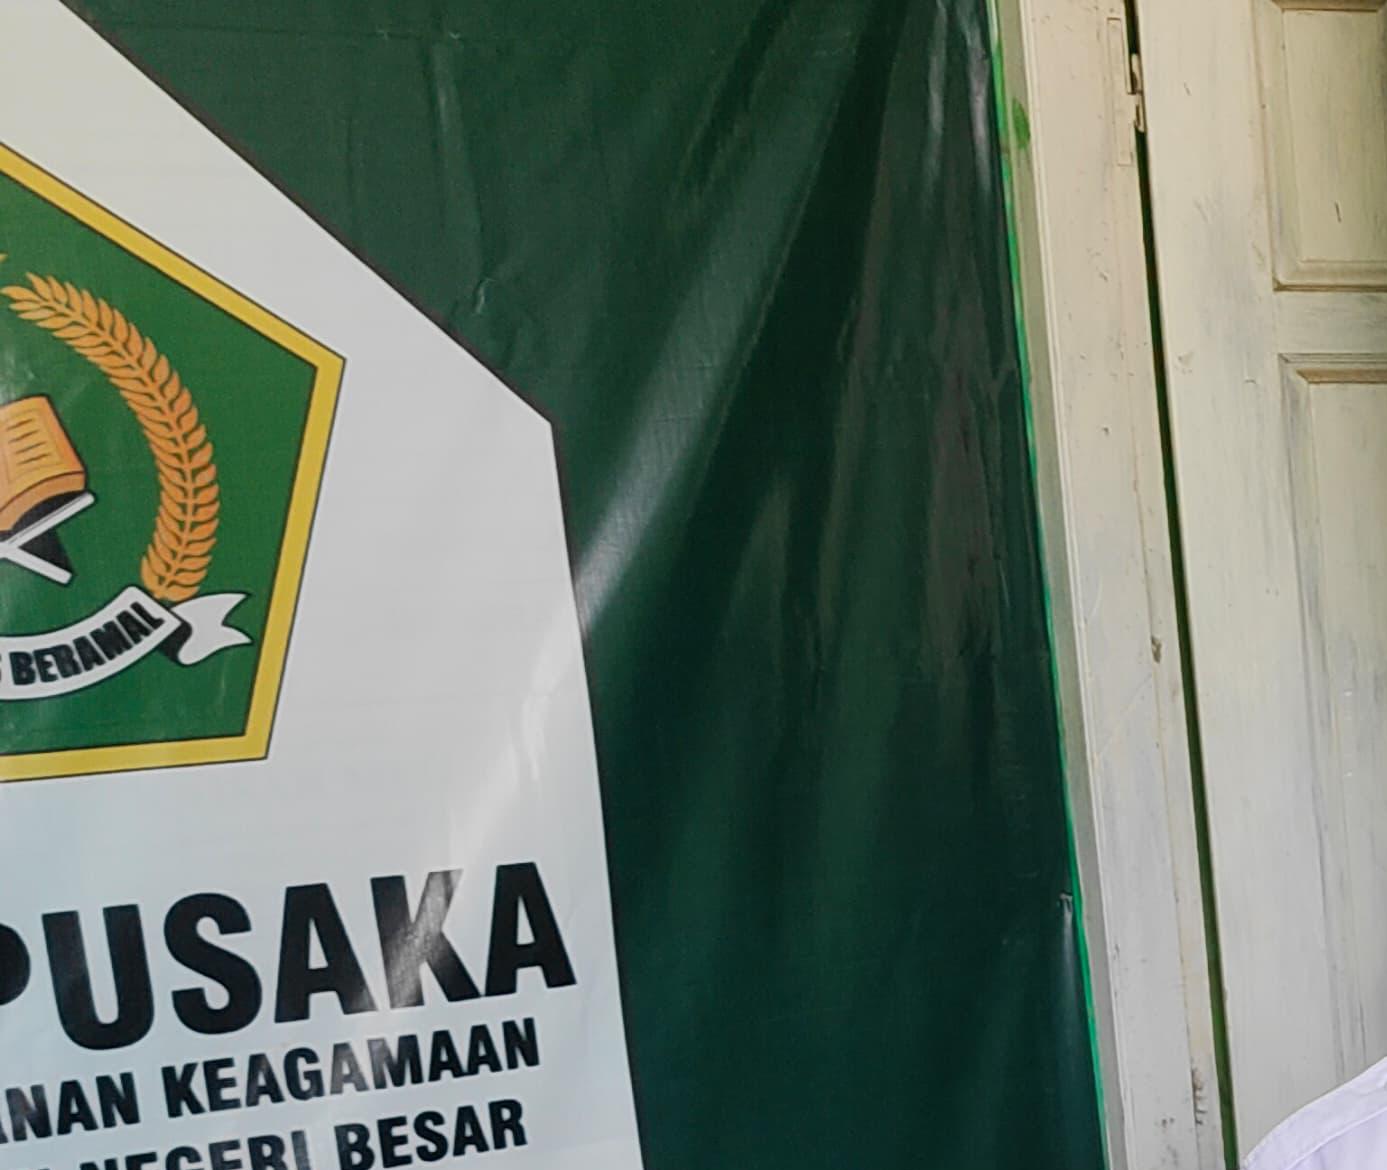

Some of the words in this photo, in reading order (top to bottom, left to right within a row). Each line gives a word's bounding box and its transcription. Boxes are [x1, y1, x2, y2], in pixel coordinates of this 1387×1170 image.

[9, 601, 165, 686] BERAMAL
[0, 1072, 140, 1144] NAN
[161, 1018, 540, 1118] KEAGAMAAN
